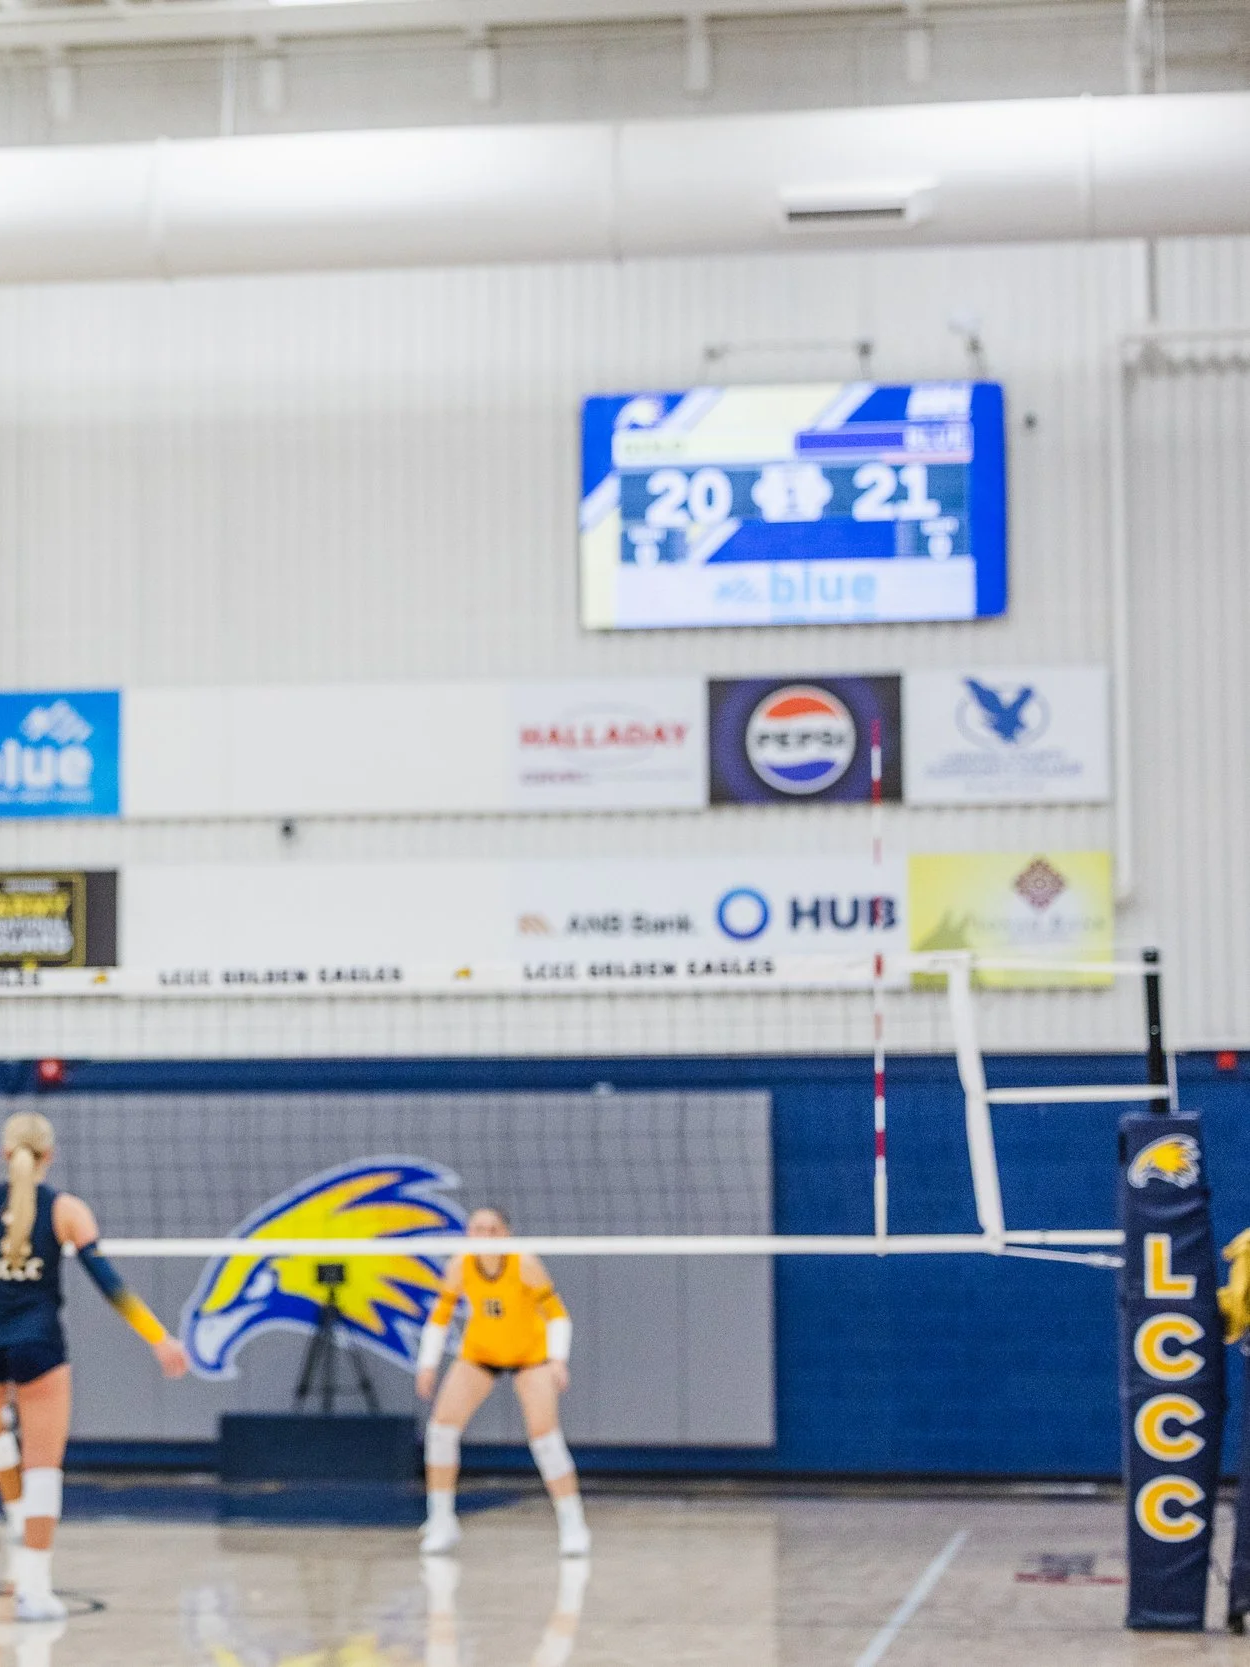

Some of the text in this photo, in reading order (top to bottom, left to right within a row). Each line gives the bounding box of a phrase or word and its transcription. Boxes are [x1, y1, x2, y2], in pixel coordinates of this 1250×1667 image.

[645, 467, 734, 527] 20
[851, 462, 942, 522] 21
[769, 562, 879, 604] blue
[519, 721, 688, 748] HALLADAY
[756, 731, 846, 748] PEPSI
[788, 896, 897, 930] HUB
[687, 957, 776, 977] EAGLES
